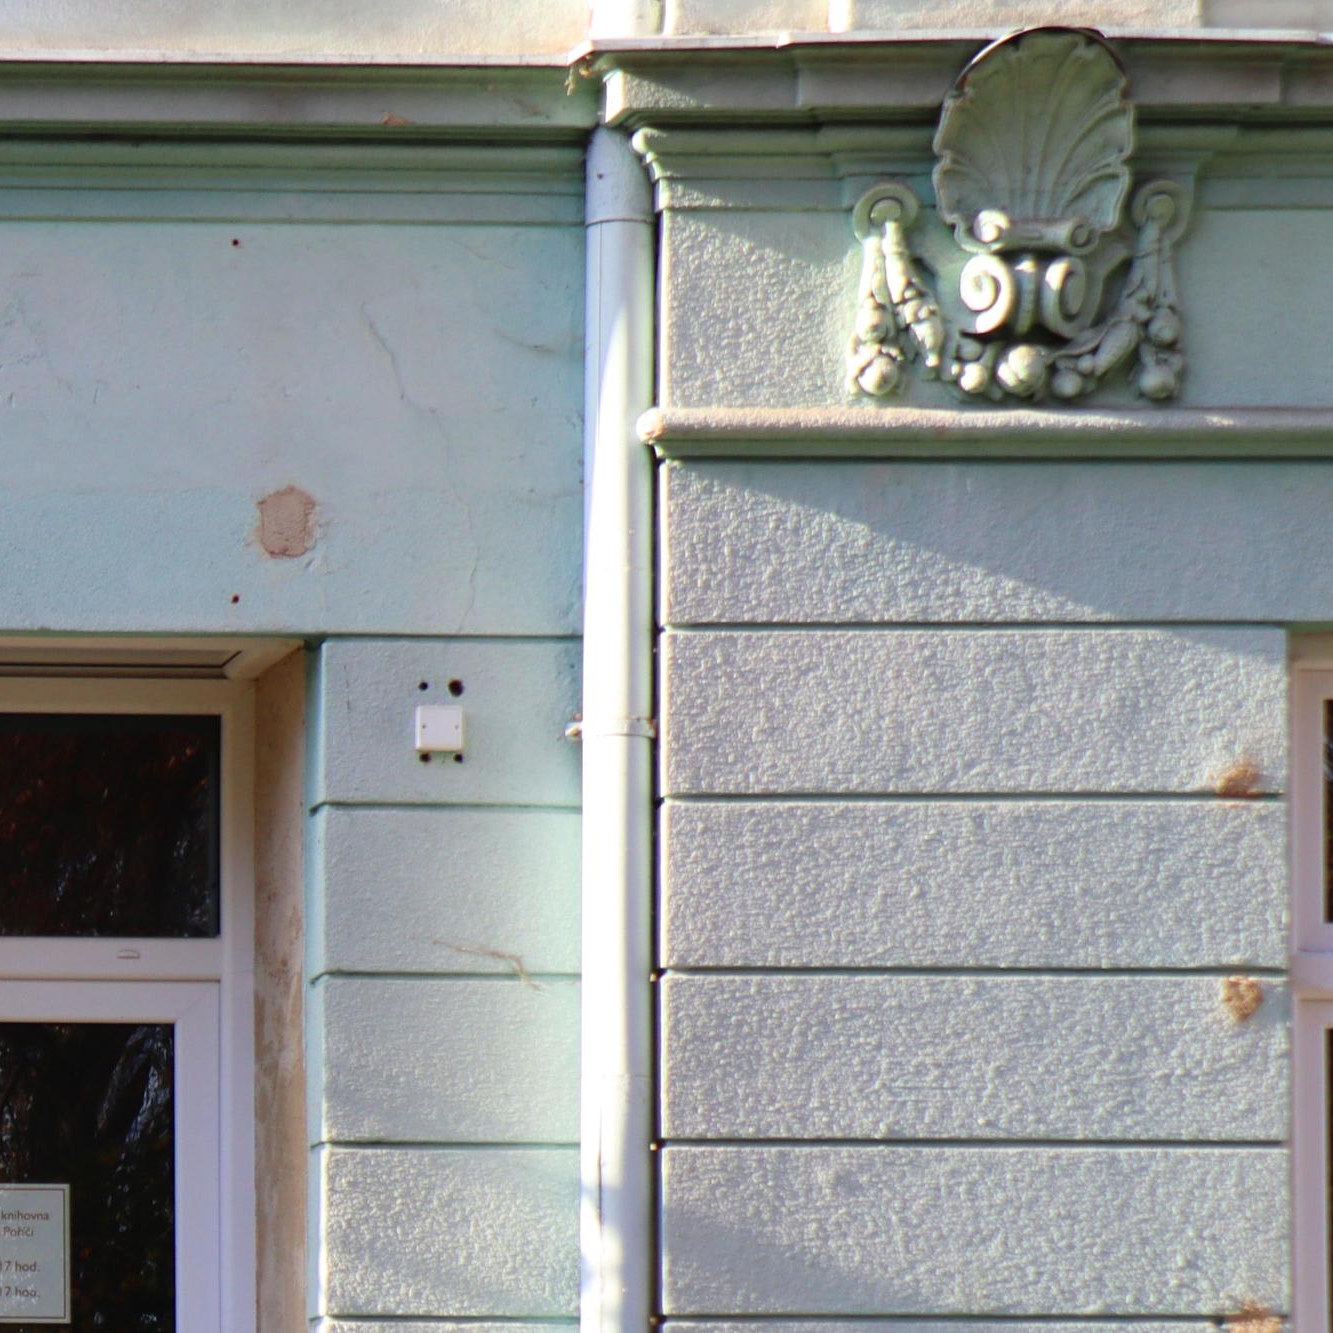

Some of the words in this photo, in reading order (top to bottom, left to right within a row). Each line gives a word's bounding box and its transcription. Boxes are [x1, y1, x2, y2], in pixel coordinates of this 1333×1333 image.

[1, 1209, 50, 1221] knihovna
[3, 1225, 35, 1237] Poříčí
[14, 1260, 41, 1272] hod.
